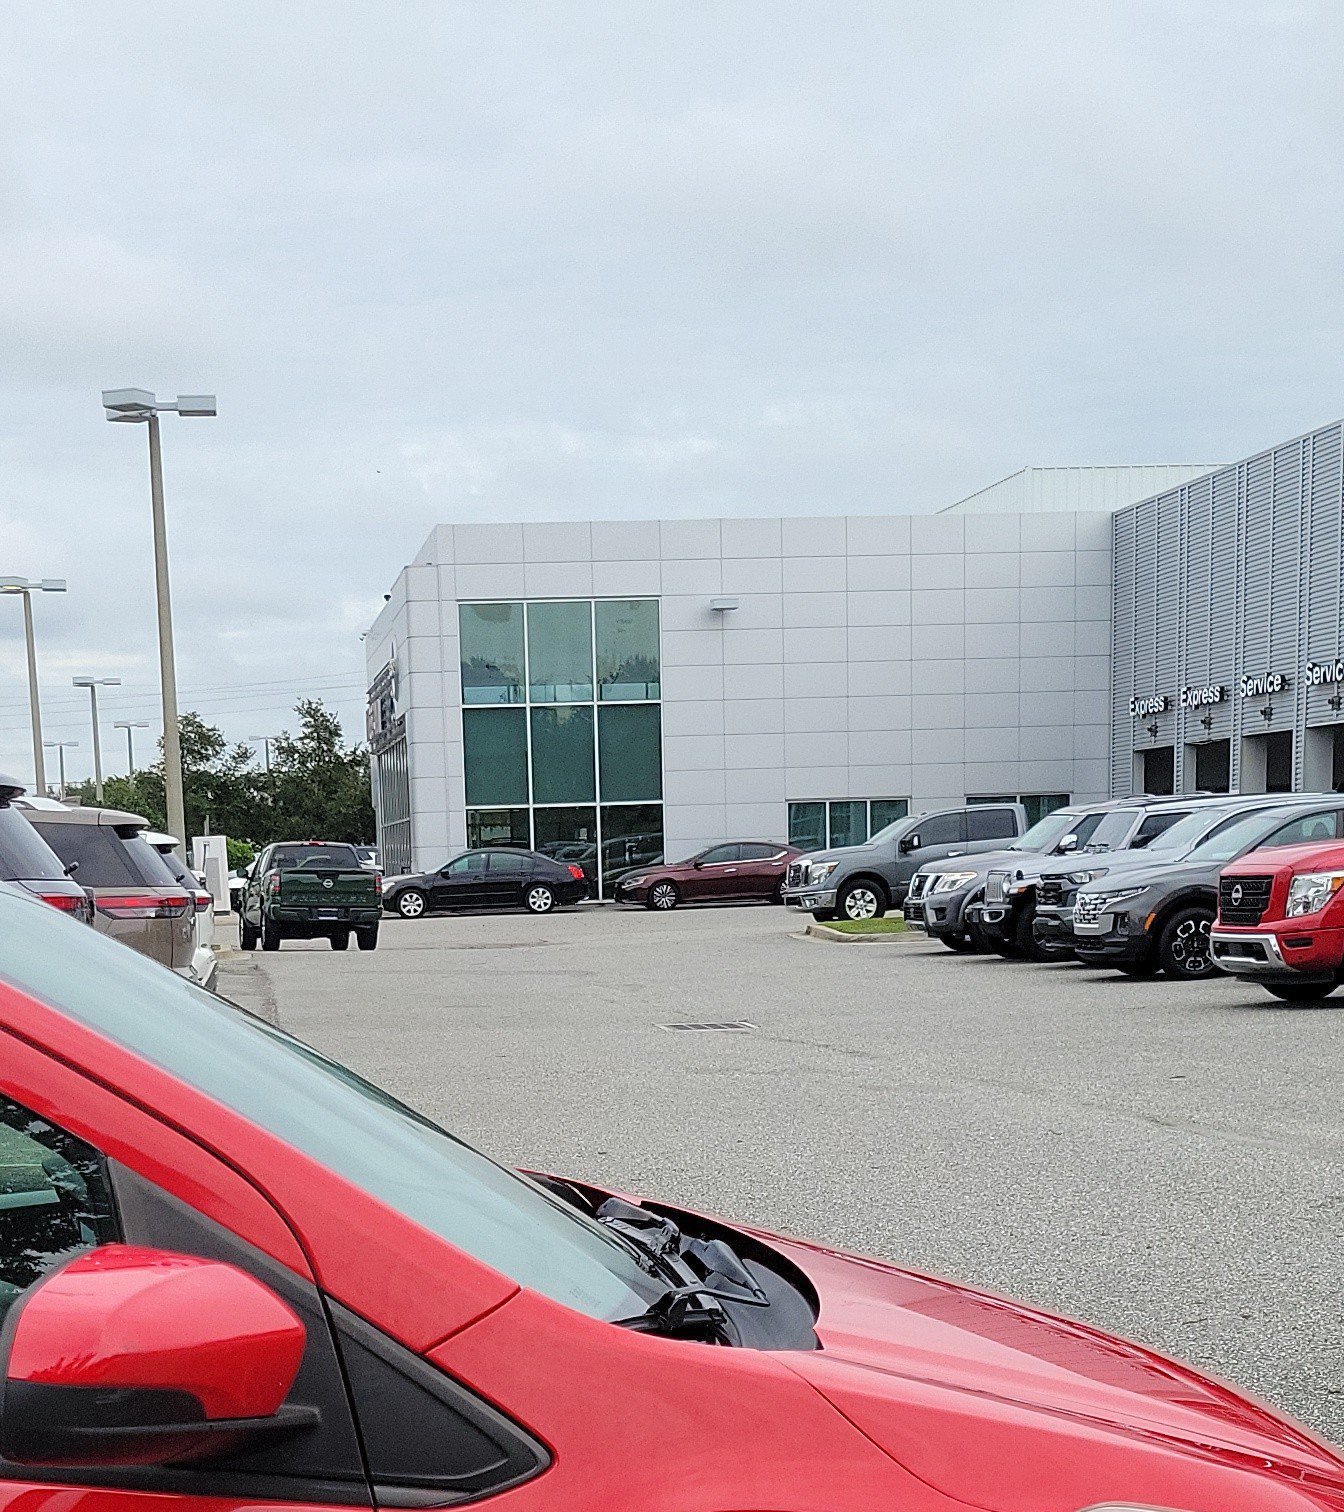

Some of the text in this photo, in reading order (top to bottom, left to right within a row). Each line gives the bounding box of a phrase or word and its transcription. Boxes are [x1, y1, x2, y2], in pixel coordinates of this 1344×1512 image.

[1239, 672, 1284, 699] Service
[1129, 695, 1168, 717] Express
[1180, 686, 1223, 709] Express
